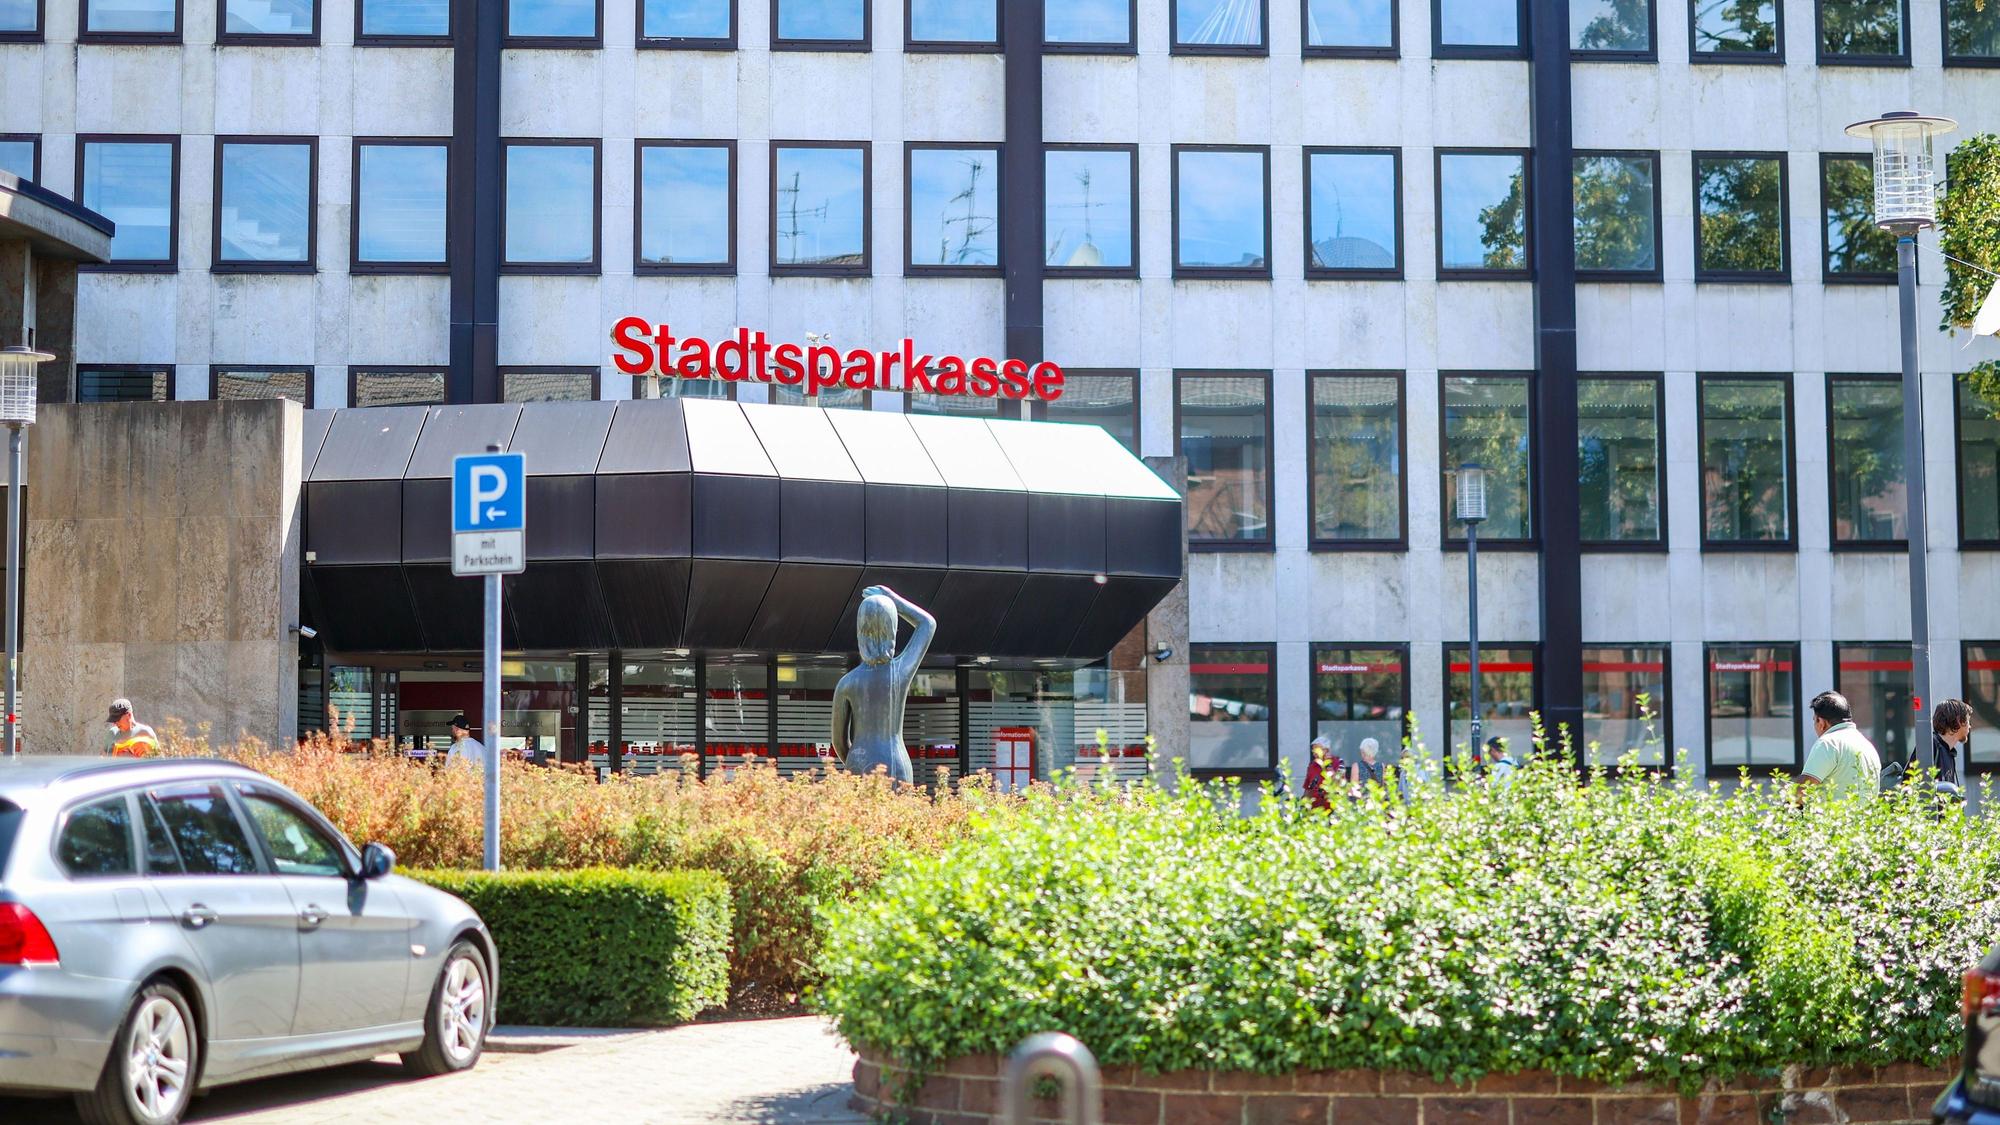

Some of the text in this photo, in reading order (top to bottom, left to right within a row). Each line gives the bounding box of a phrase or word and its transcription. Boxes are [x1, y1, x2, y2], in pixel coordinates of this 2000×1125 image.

[610, 315, 1066, 401] Stadtsparkasse
[470, 464, 507, 525] P
[481, 539, 496, 549] mit
[464, 554, 513, 566] Parkschein
[1321, 664, 1368, 672] Stadtsparkasse
[1715, 663, 1761, 671] Stadtsparkasse
